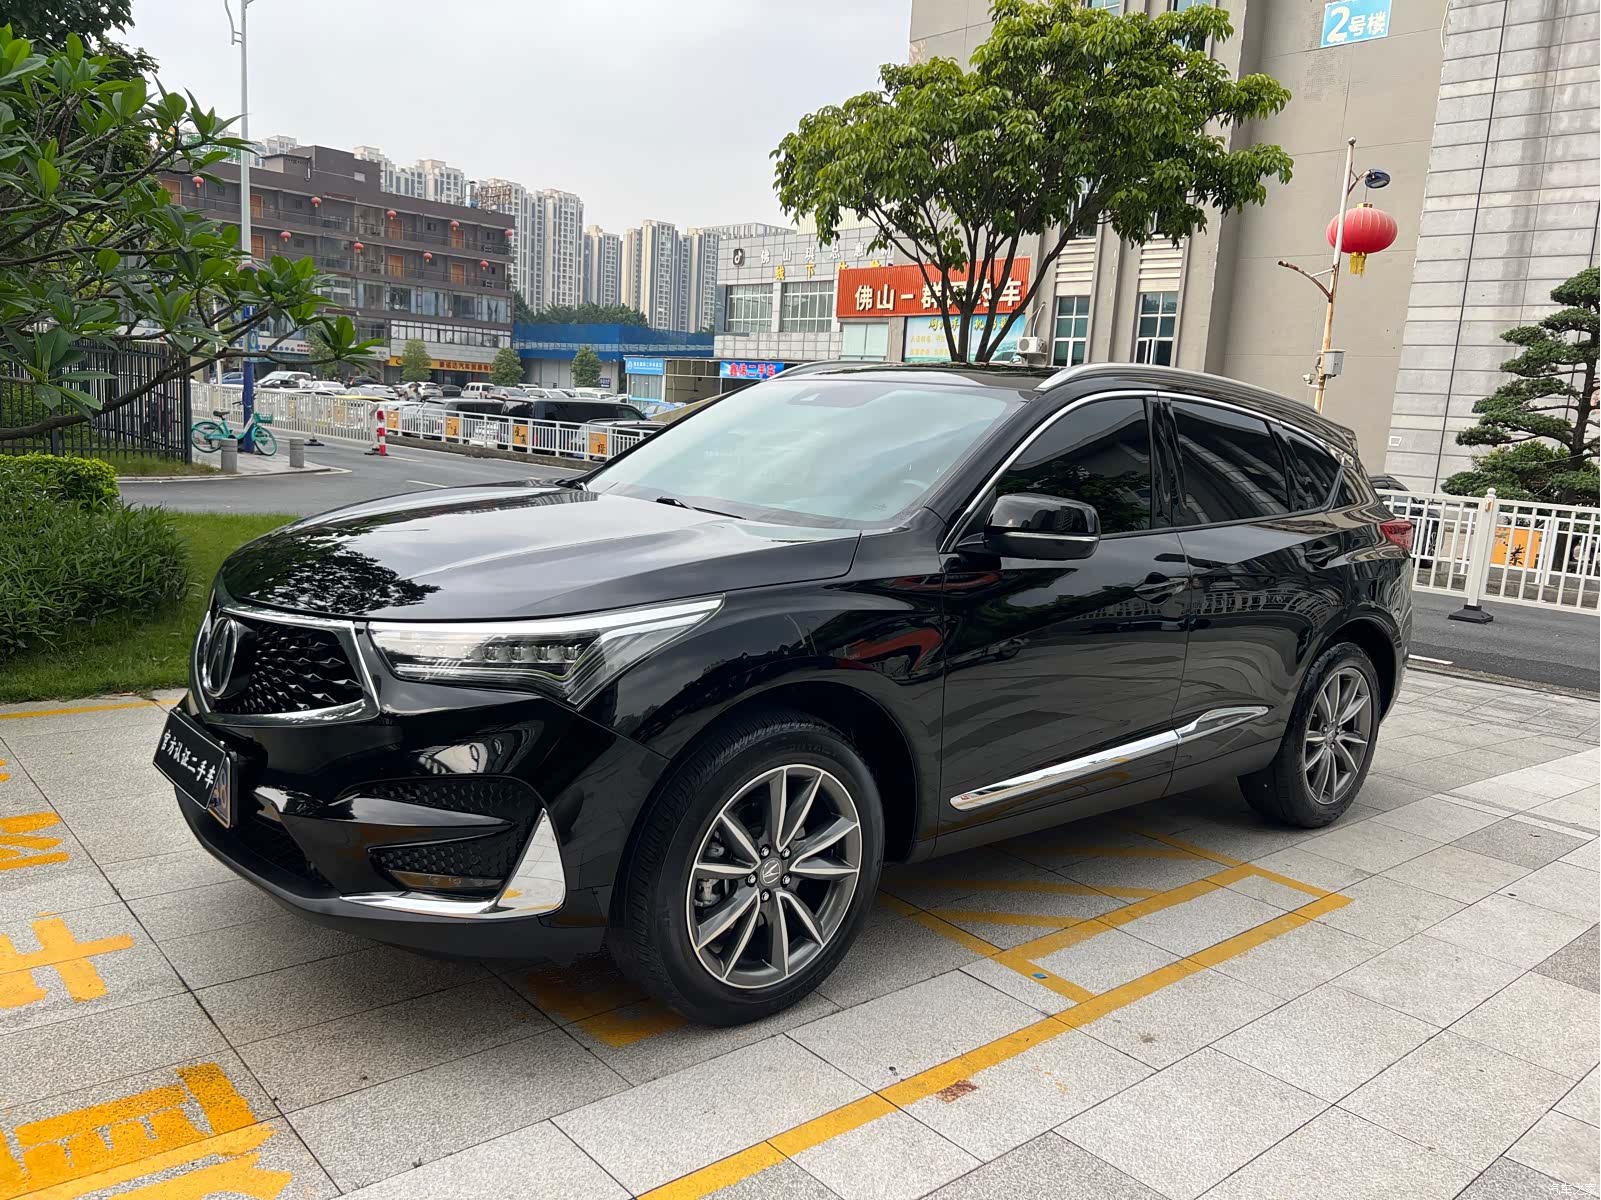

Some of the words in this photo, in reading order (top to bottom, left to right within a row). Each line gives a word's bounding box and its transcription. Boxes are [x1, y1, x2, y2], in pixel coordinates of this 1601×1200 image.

[1326, 6, 1387, 43] 2号楼
[161, 729, 216, 789] 官方认证二手车
